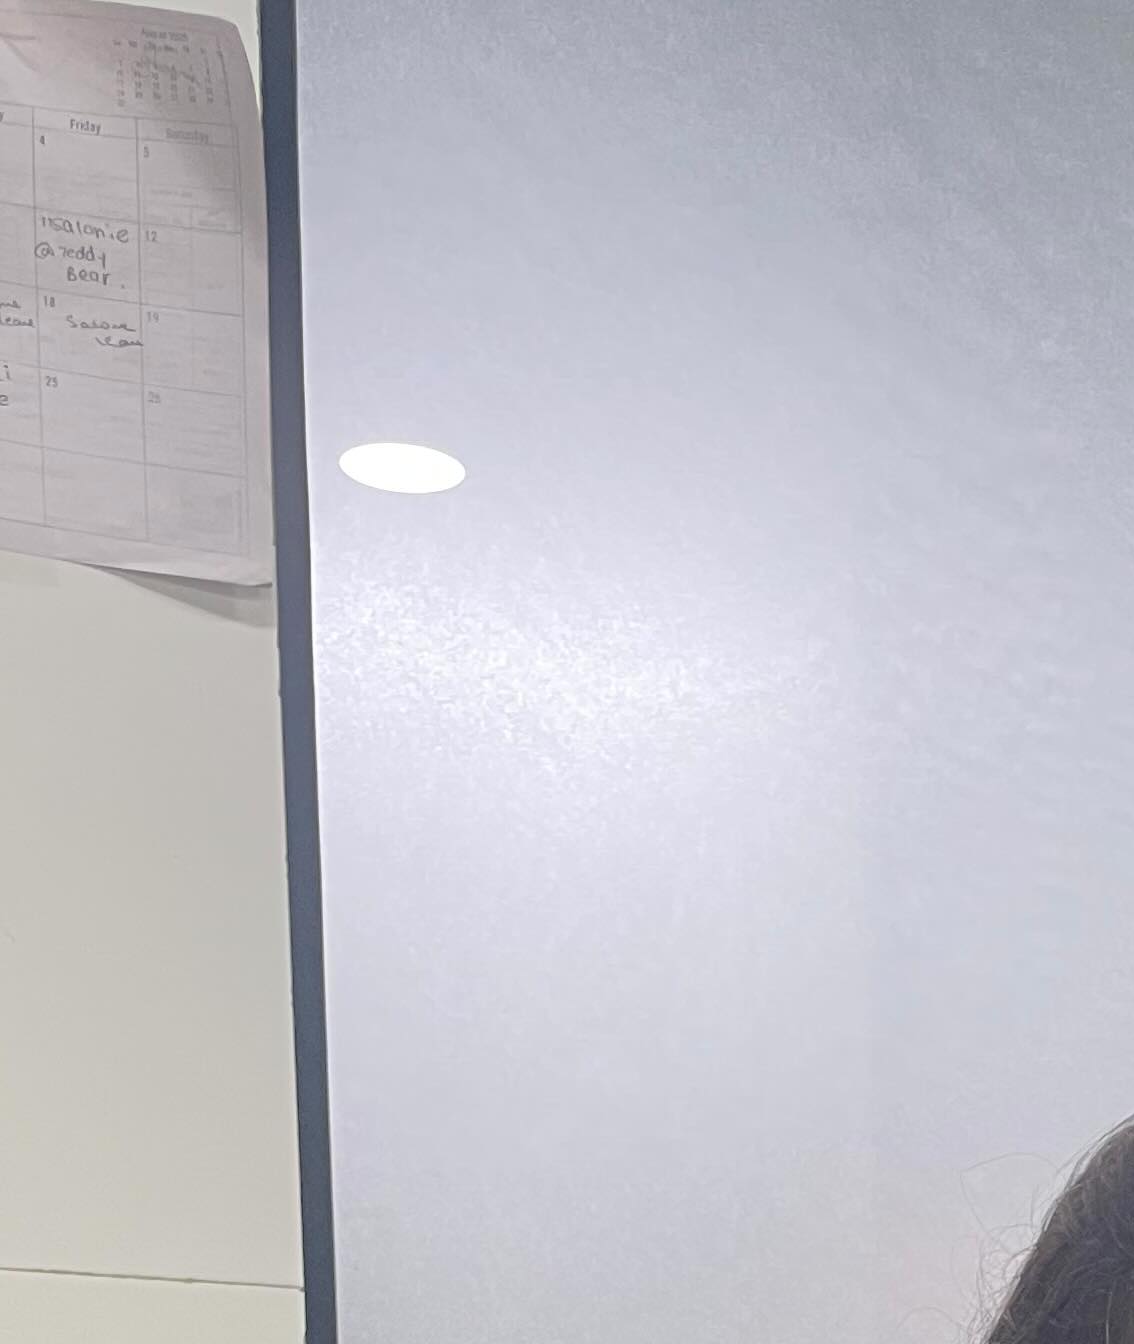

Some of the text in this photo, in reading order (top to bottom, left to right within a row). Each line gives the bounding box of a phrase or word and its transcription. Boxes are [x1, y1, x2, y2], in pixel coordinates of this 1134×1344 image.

[69, 117, 102, 136] Friday
[145, 230, 158, 242] 12
[44, 295, 55, 308] 18
